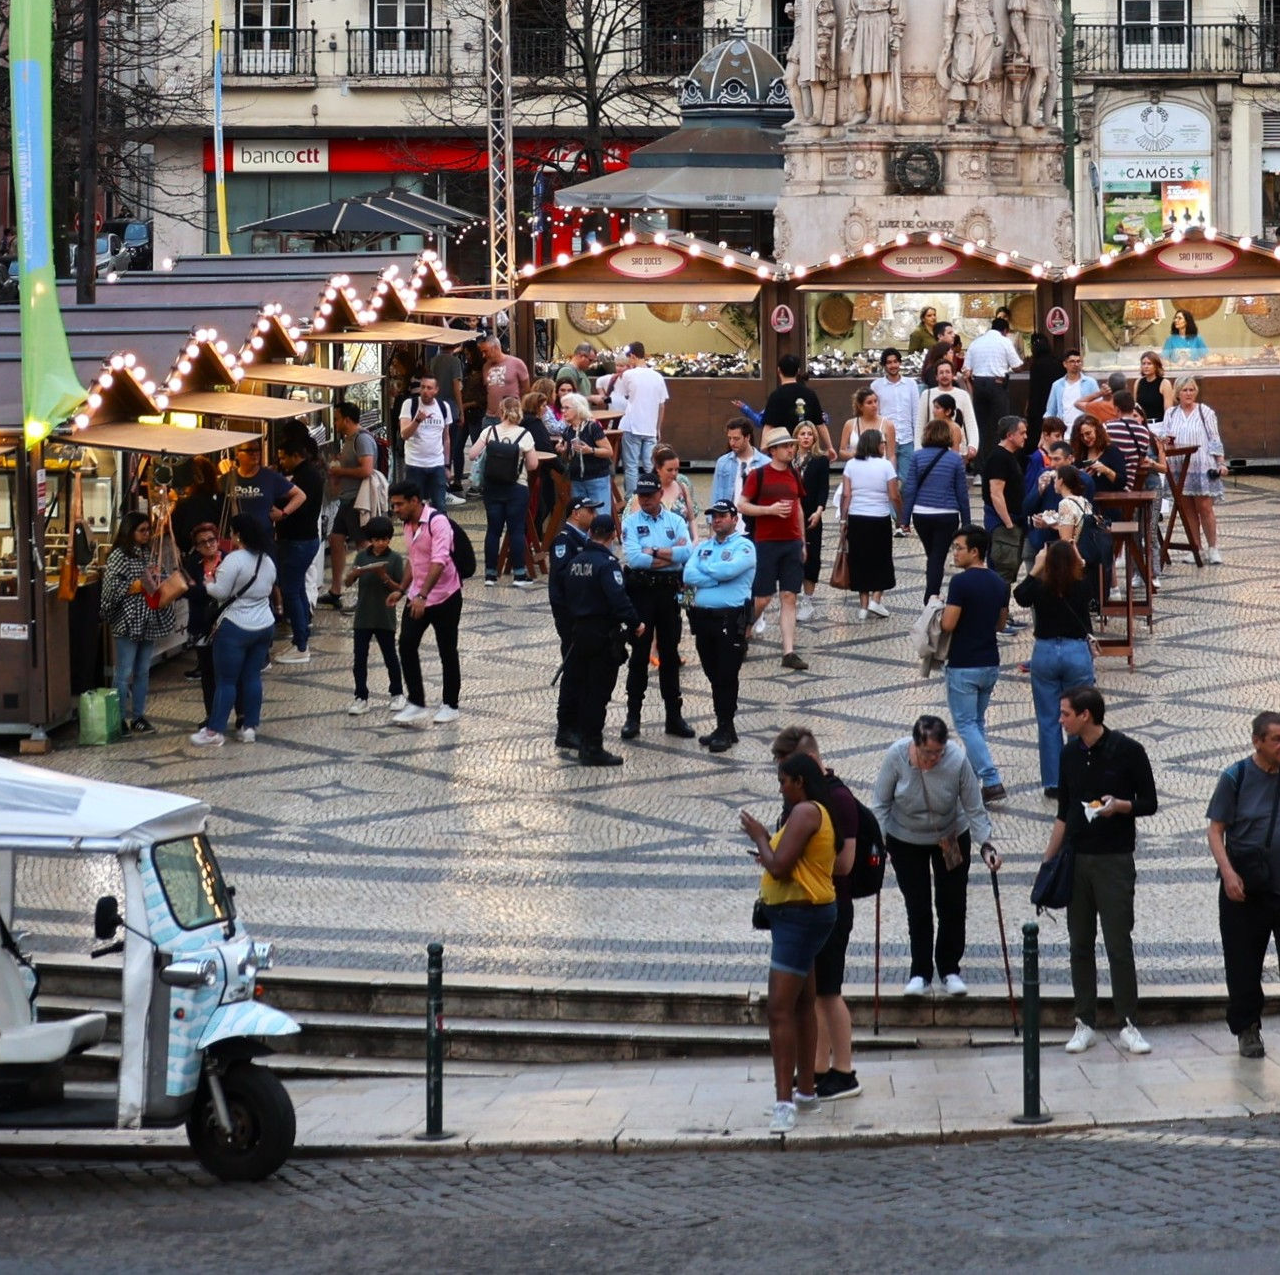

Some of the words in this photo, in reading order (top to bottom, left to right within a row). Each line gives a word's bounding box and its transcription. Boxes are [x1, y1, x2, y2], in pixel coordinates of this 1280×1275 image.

[1126, 165, 1184, 179] CAMÕES
[902, 220, 915, 229] DE
[909, 256, 944, 265] CHOCOLATES
[1192, 252, 1213, 261] FRUTAS
[234, 485, 261, 494] Polo
